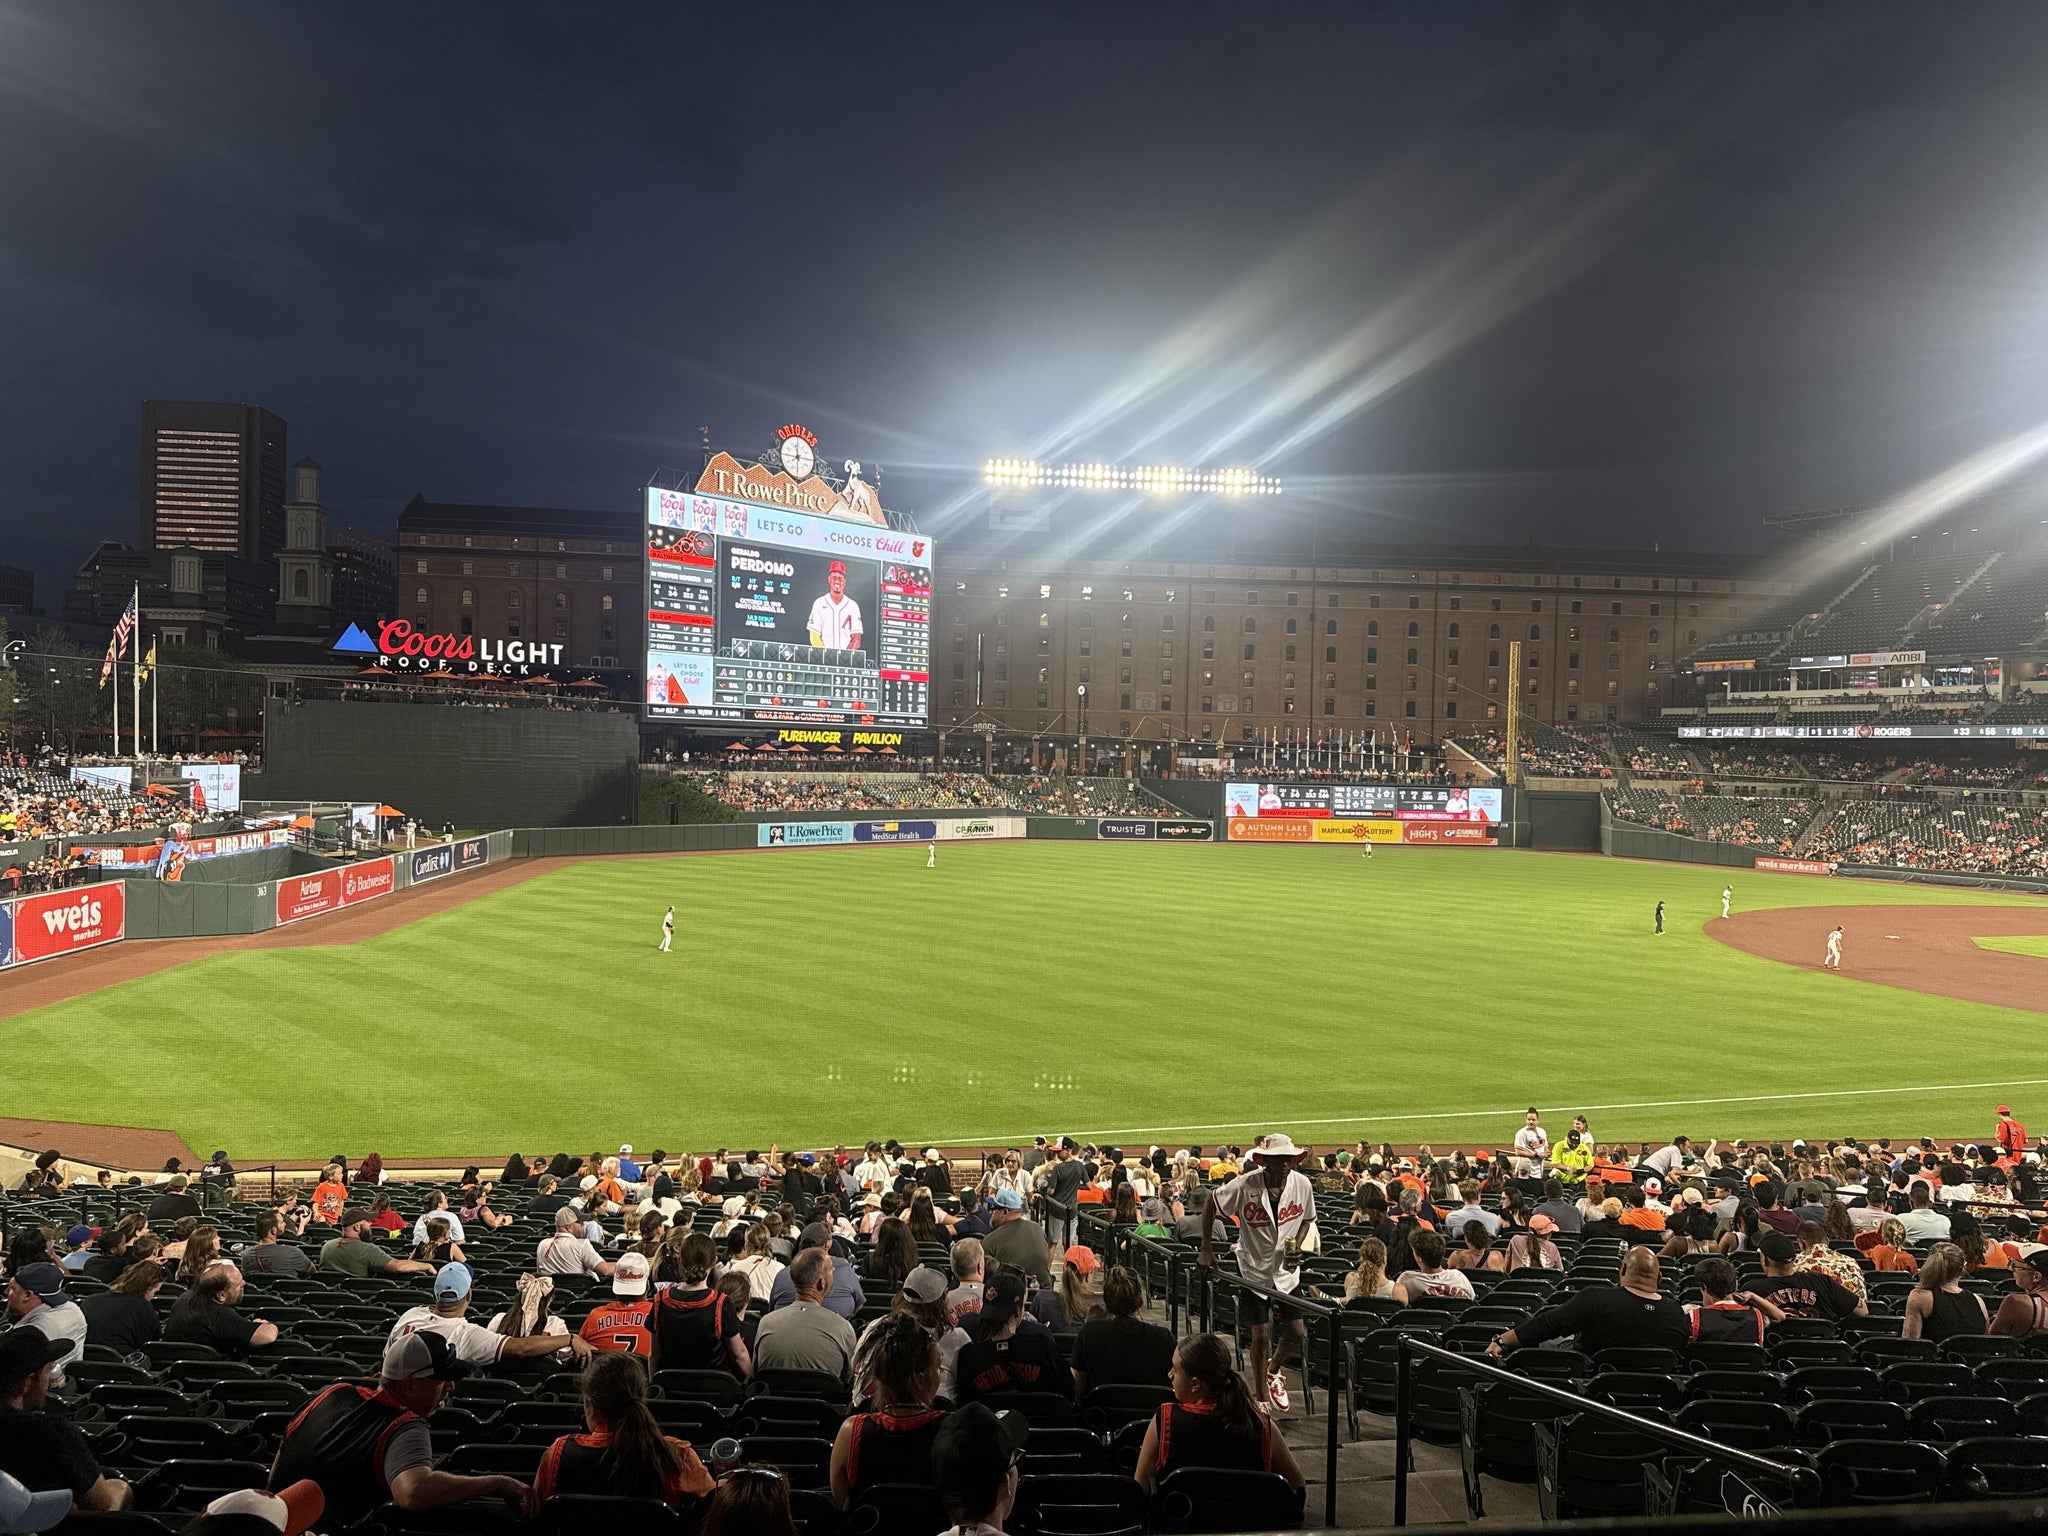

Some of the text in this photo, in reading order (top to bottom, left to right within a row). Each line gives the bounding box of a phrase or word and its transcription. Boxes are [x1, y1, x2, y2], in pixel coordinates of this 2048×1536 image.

[778, 424, 819, 447] ORIOLES
[757, 518, 803, 536] LET'S GO
[830, 532, 905, 554] CHOOSE Chill
[653, 553, 684, 561] BALTIMORE
[731, 547, 760, 557] GERALDO
[731, 556, 794, 577] PERDOMO
[378, 619, 564, 666] Coors LIGHT
[380, 655, 529, 675] ROOF DECK
[1890, 653, 1921, 663] AMBI
[778, 730, 902, 745] PUREWAGER PAVILION
[1683, 729, 1700, 737] 7:58
[1734, 729, 1804, 737] AZ 3 BAL 2
[1847, 728, 1854, 736] 2
[1874, 728, 1911, 736] ROGERS
[1959, 728, 1970, 736] 33
[2011, 728, 2023, 736] 88
[2039, 728, 2045, 736] 6
[871, 831, 920, 841] MedStar Health
[1409, 829, 1438, 840] HIGH'S
[216, 837, 239, 854] BIRD
[241, 834, 264, 850] BATH
[101, 848, 124, 860] BIRD
[415, 854, 440, 876] CareFirst
[1757, 860, 1818, 872] weis markets
[300, 879, 323, 897] Airtemp
[357, 874, 391, 892] Budweiser
[257, 886, 267, 897] 363
[42, 895, 102, 936] weis
[73, 928, 102, 942] markets
[597, 1312, 650, 1332] HOLLID
[613, 1334, 639, 1353] 7
